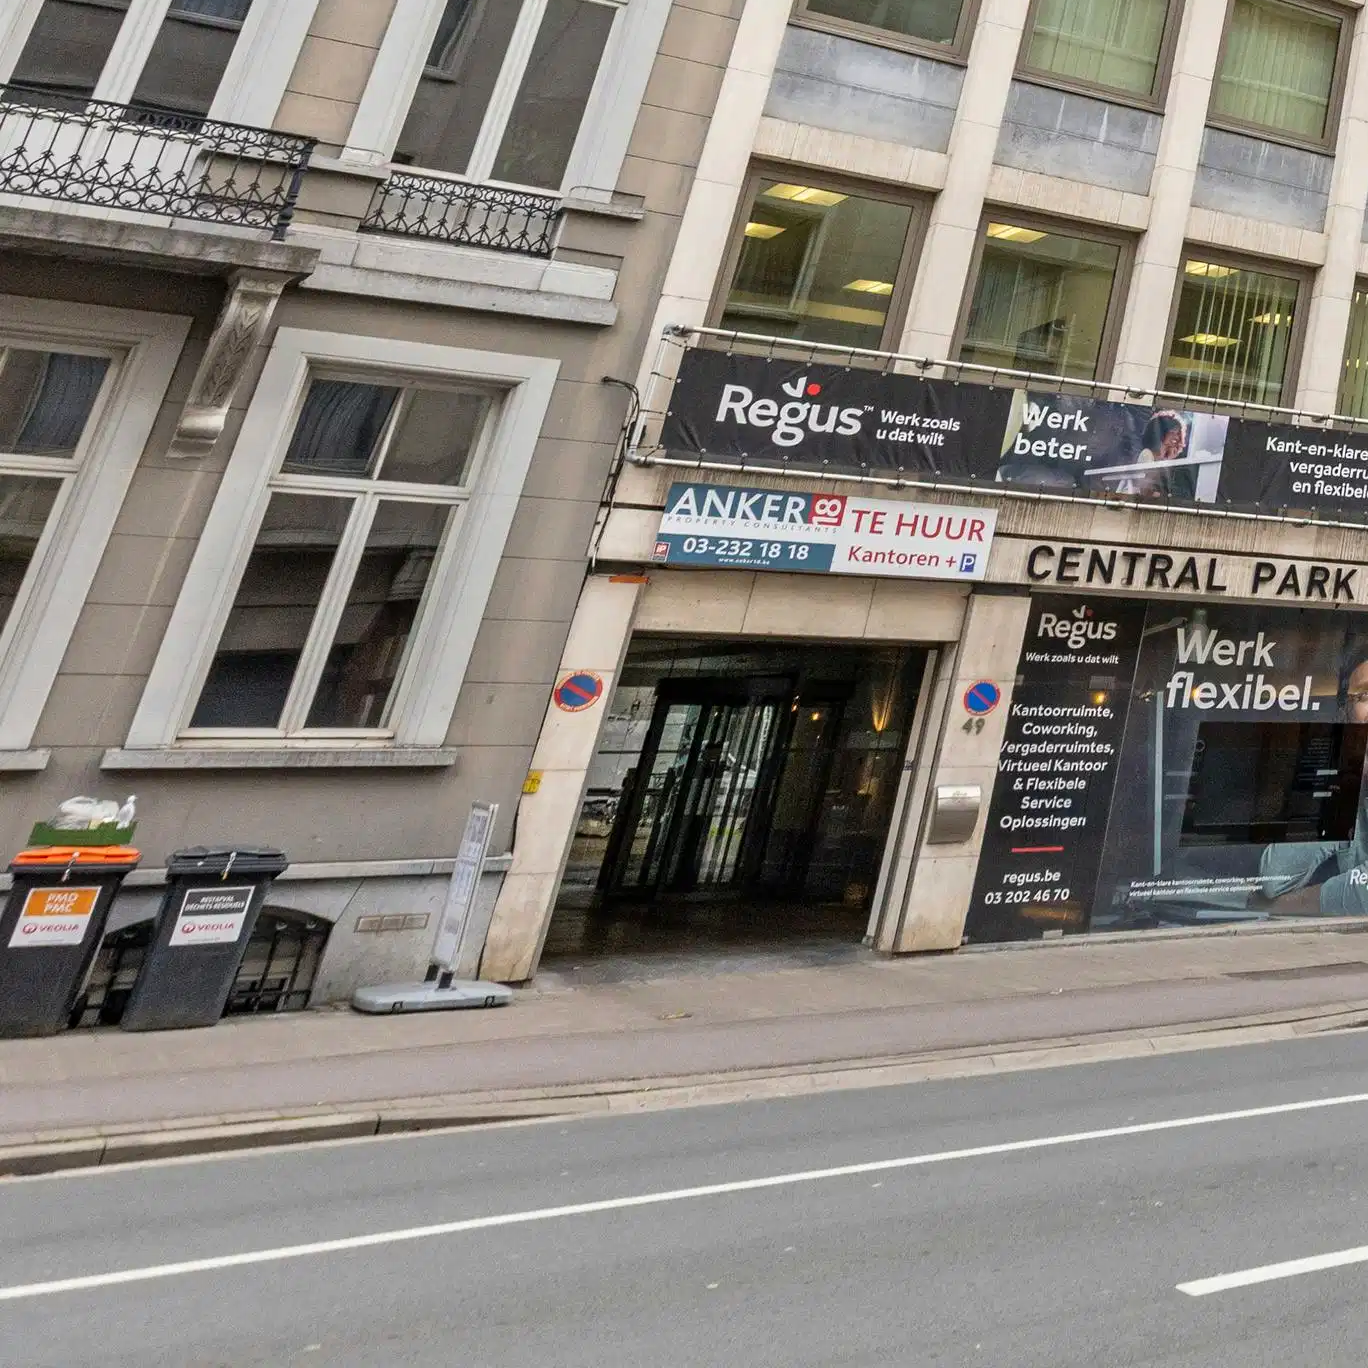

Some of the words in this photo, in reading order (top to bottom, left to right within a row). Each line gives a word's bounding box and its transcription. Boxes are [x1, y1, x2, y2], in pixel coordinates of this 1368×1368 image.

[715, 382, 866, 447] Regus
[880, 409, 920, 428] Werk
[922, 415, 961, 432] zoals
[1021, 403, 1089, 432] Werk
[875, 430, 887, 441] u
[888, 429, 914, 444] dat
[916, 432, 945, 447] wilt
[1013, 432, 1092, 462] beter.
[1292, 483, 1311, 494] en
[669, 487, 806, 525] ANKER
[667, 515, 736, 527] PROPERTY
[744, 519, 838, 534] CONSULTANTS
[851, 509, 888, 535] TE
[895, 513, 986, 542] HUUR
[683, 537, 753, 557] 03-232
[759, 542, 781, 559] 18
[788, 544, 810, 561] 18
[848, 546, 939, 568] Kantoren
[1026, 544, 1227, 592] CENTRAL
[1250, 561, 1358, 601] PARK
[1037, 612, 1118, 649] Regus
[1176, 627, 1277, 668] Werk
[1025, 652, 1050, 663] Werk
[1051, 653, 1076, 664] zoals
[1077, 656, 1084, 664] u
[1085, 654, 1100, 664] dat
[1101, 654, 1119, 665] wilt
[1165, 671, 1321, 711] flexibel.
[1012, 704, 1114, 720] Kantoorruimte,
[961, 717, 986, 735] 49
[1022, 723, 1098, 739] Coworking,
[998, 759, 1051, 772] Virtueel
[1053, 759, 1107, 772] Kantoor
[1013, 780, 1023, 791] &
[1026, 777, 1086, 790] Flexibele
[1021, 796, 1072, 809] Service
[1000, 816, 1086, 831] Oplossingen
[1002, 870, 1061, 886] regus.be
[47, 892, 80, 902] PMD
[984, 892, 1000, 905] 03
[1001, 891, 1030, 904] 202
[1033, 890, 1051, 902] 46
[1053, 888, 1070, 901] 70
[44, 903, 75, 913] PMC
